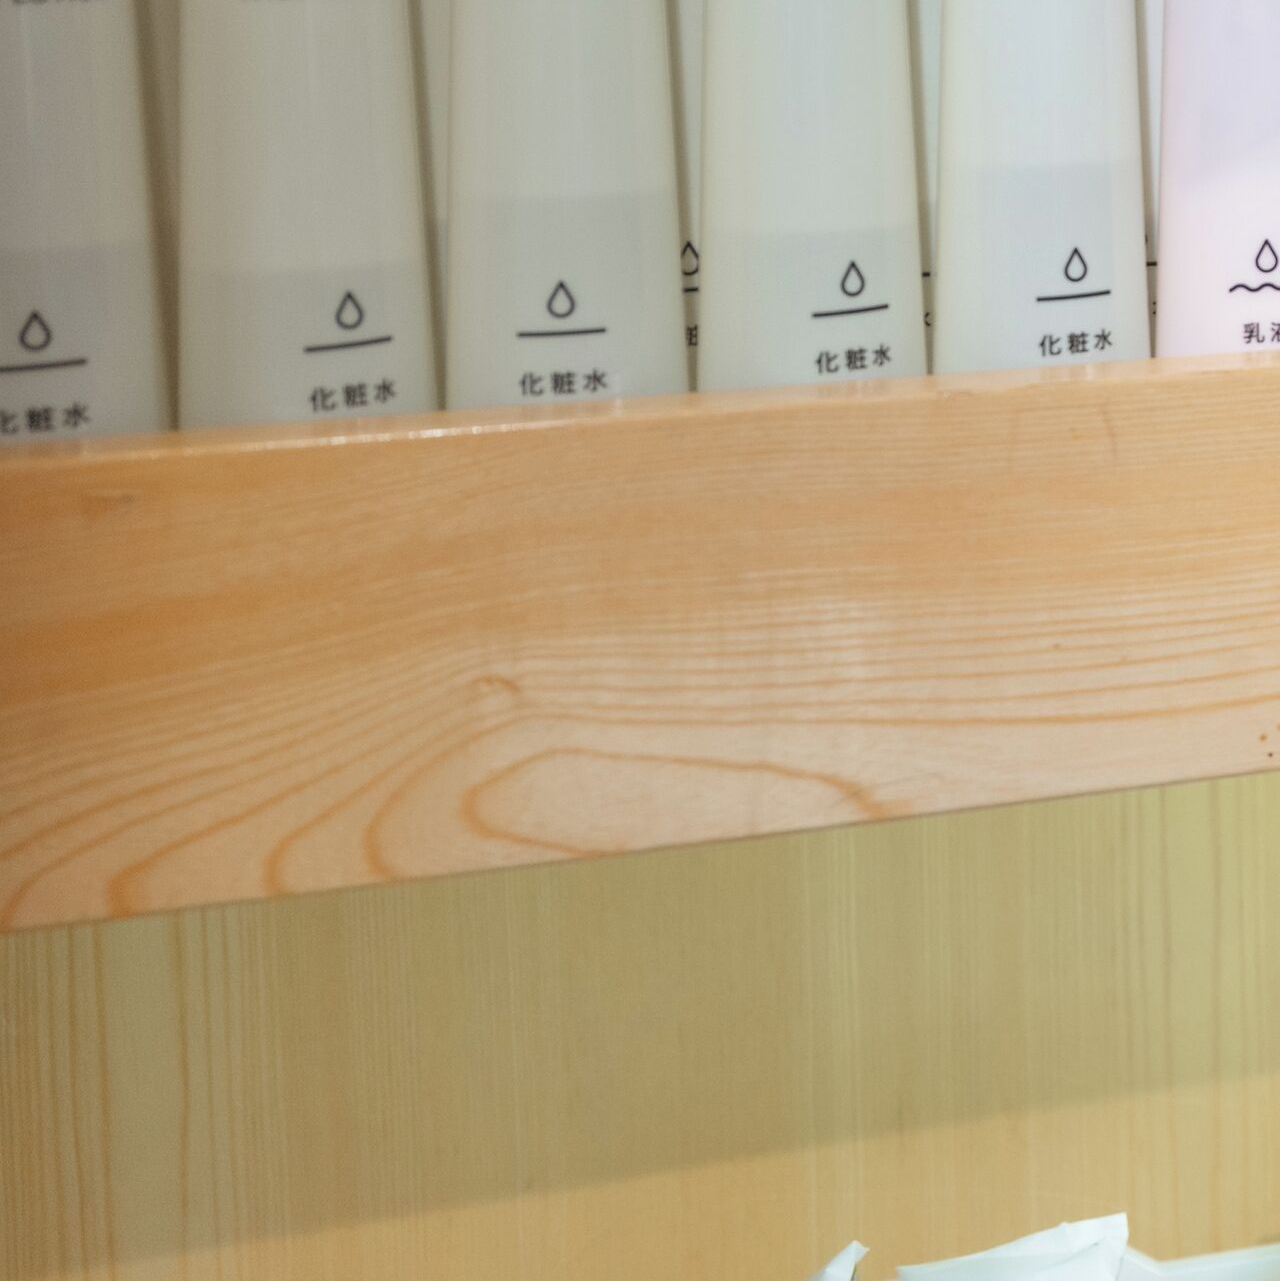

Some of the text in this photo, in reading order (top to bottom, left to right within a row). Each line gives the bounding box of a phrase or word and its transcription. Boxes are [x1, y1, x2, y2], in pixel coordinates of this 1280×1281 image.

[1038, 328, 1114, 358] 化粧水
[815, 343, 893, 376] 化粧水
[310, 378, 397, 413] 化粧水
[519, 368, 608, 397] 化粧水
